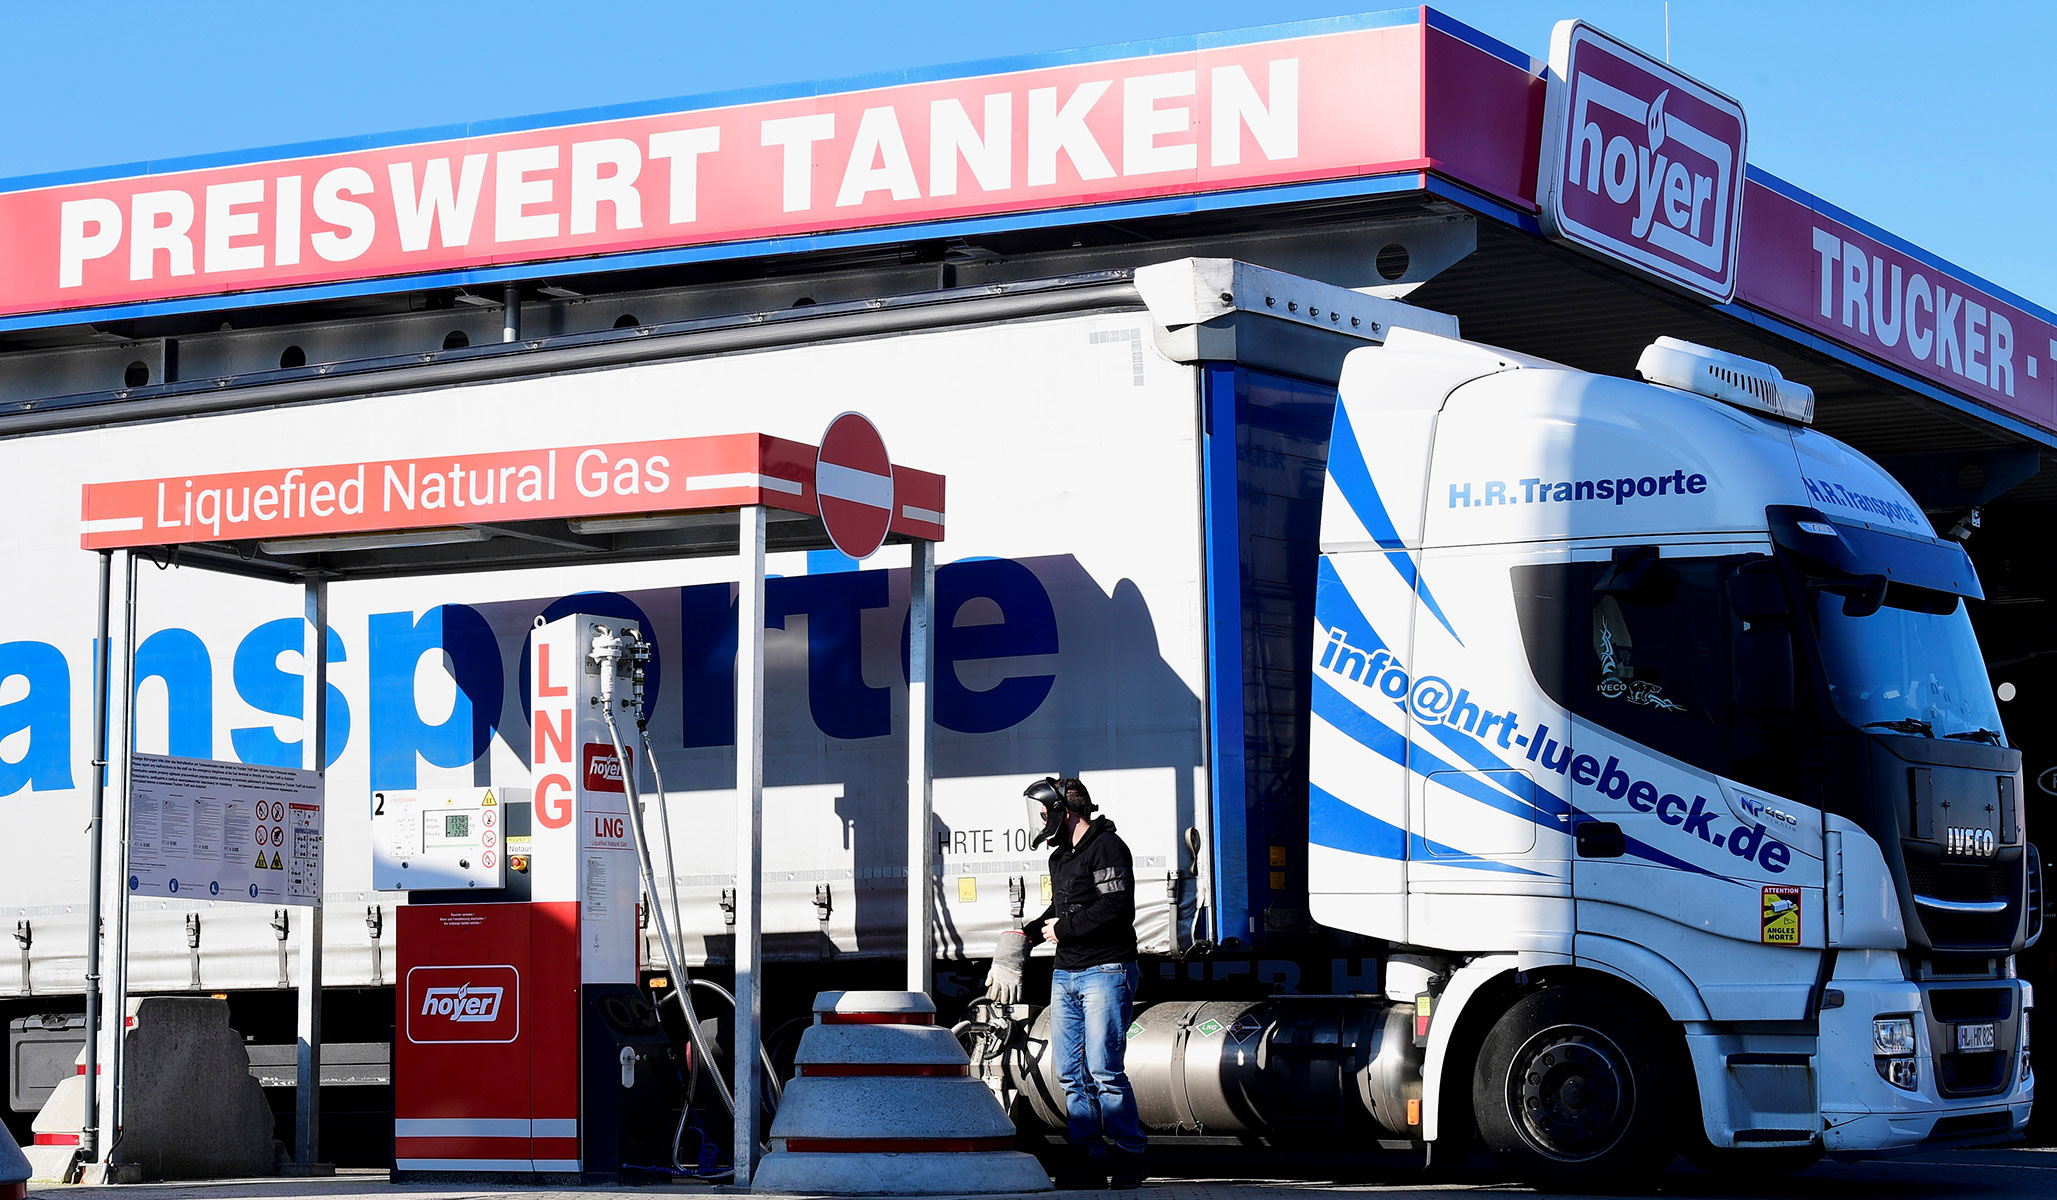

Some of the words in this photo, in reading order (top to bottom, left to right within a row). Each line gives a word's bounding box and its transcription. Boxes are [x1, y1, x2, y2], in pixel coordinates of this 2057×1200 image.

[58, 126, 720, 289] PREISWERT
[760, 58, 1298, 212] TANKEN
[1568, 116, 1712, 240] hoyer
[1812, 226, 2015, 398] TRUCKER
[157, 464, 364, 536] Liquefied
[382, 451, 556, 511] Natural
[573, 448, 670, 498] Gas
[1448, 469, 1708, 508] H.R.Transporte
[1802, 477, 1919, 525] H.R.Transporte
[1597, 684, 1627, 692] IVECO
[534, 643, 573, 830] LNG
[1319, 626, 1791, 874] info@hrt-luebeck.de
[374, 792, 385, 816] 2
[1740, 795, 1763, 818] NP
[1765, 806, 1797, 826] 460
[595, 817, 624, 839] LNG
[938, 829, 993, 855] HRTE
[1947, 826, 1994, 857] IVECO
[421, 985, 494, 1021] hoyer
[1127, 1026, 1140, 1034] NG
